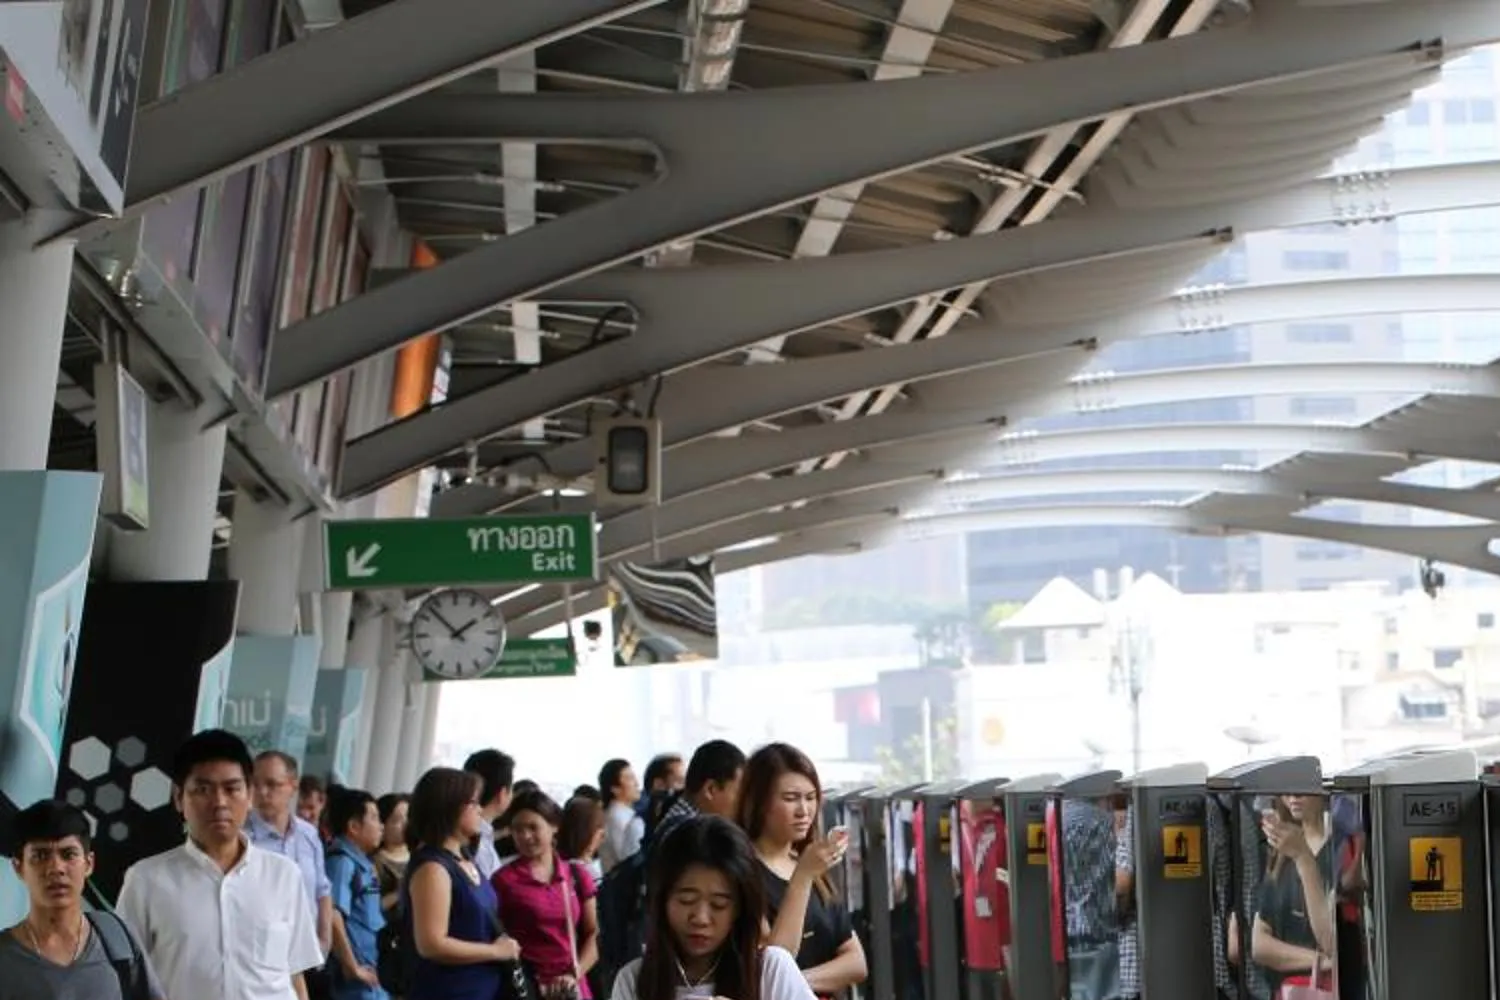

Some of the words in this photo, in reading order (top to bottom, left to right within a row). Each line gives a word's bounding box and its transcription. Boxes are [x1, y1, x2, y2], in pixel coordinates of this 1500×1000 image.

[467, 523, 575, 551] ทางออก
[532, 552, 575, 571] Exit
[1409, 801, 1457, 817] AE-15
